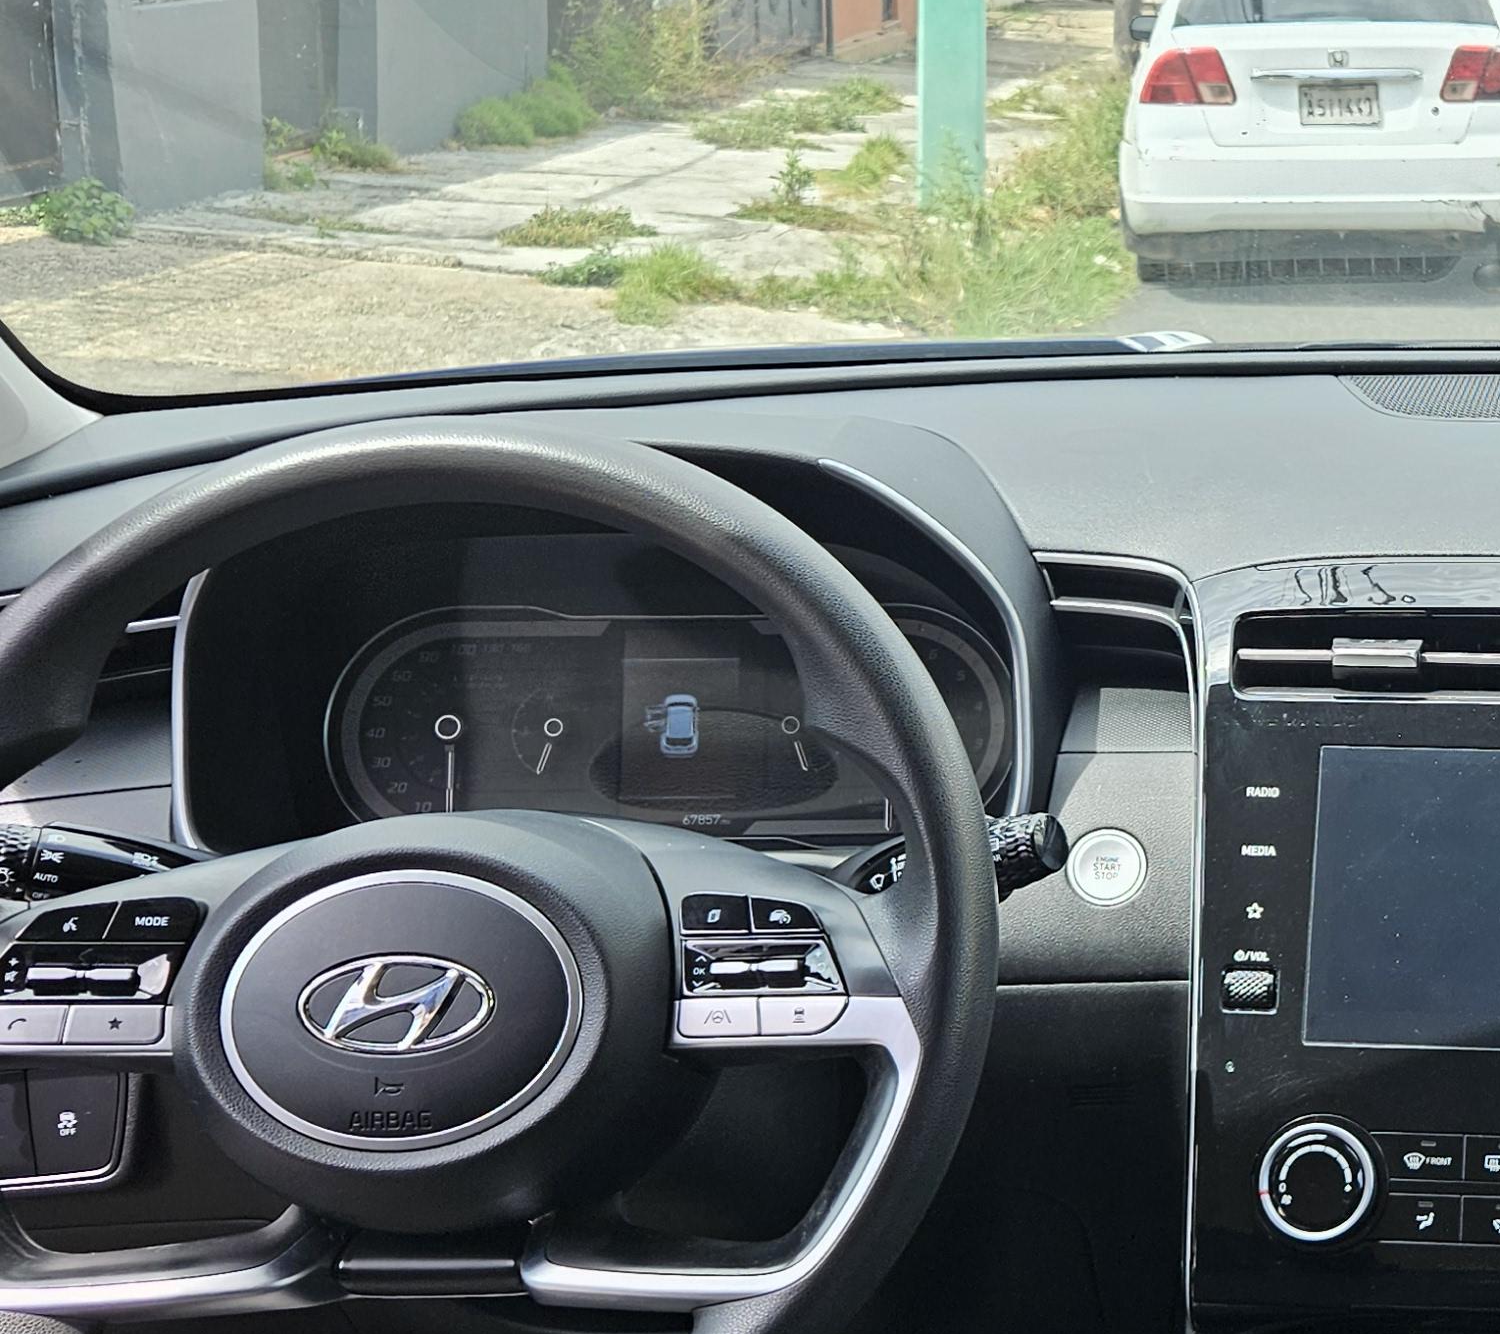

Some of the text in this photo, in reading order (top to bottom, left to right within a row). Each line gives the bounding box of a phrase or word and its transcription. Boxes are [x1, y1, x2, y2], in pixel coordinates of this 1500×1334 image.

[373, 696, 392, 707] 50
[367, 727, 386, 738] 40
[387, 783, 407, 794] 20
[1246, 787, 1280, 798] RADIO
[414, 802, 432, 813] 10
[682, 813, 721, 826] 67857
[1241, 845, 1277, 857] MEDIA
[1093, 862, 1121, 871] START
[33, 872, 59, 883] AUTO
[1094, 871, 1119, 880] STOP
[134, 916, 171, 927] MODE
[693, 966, 706, 975] OK
[349, 1111, 433, 1132] AIRBAG
[60, 1128, 77, 1137] OFF
[1425, 1156, 1452, 1166] FRONT
